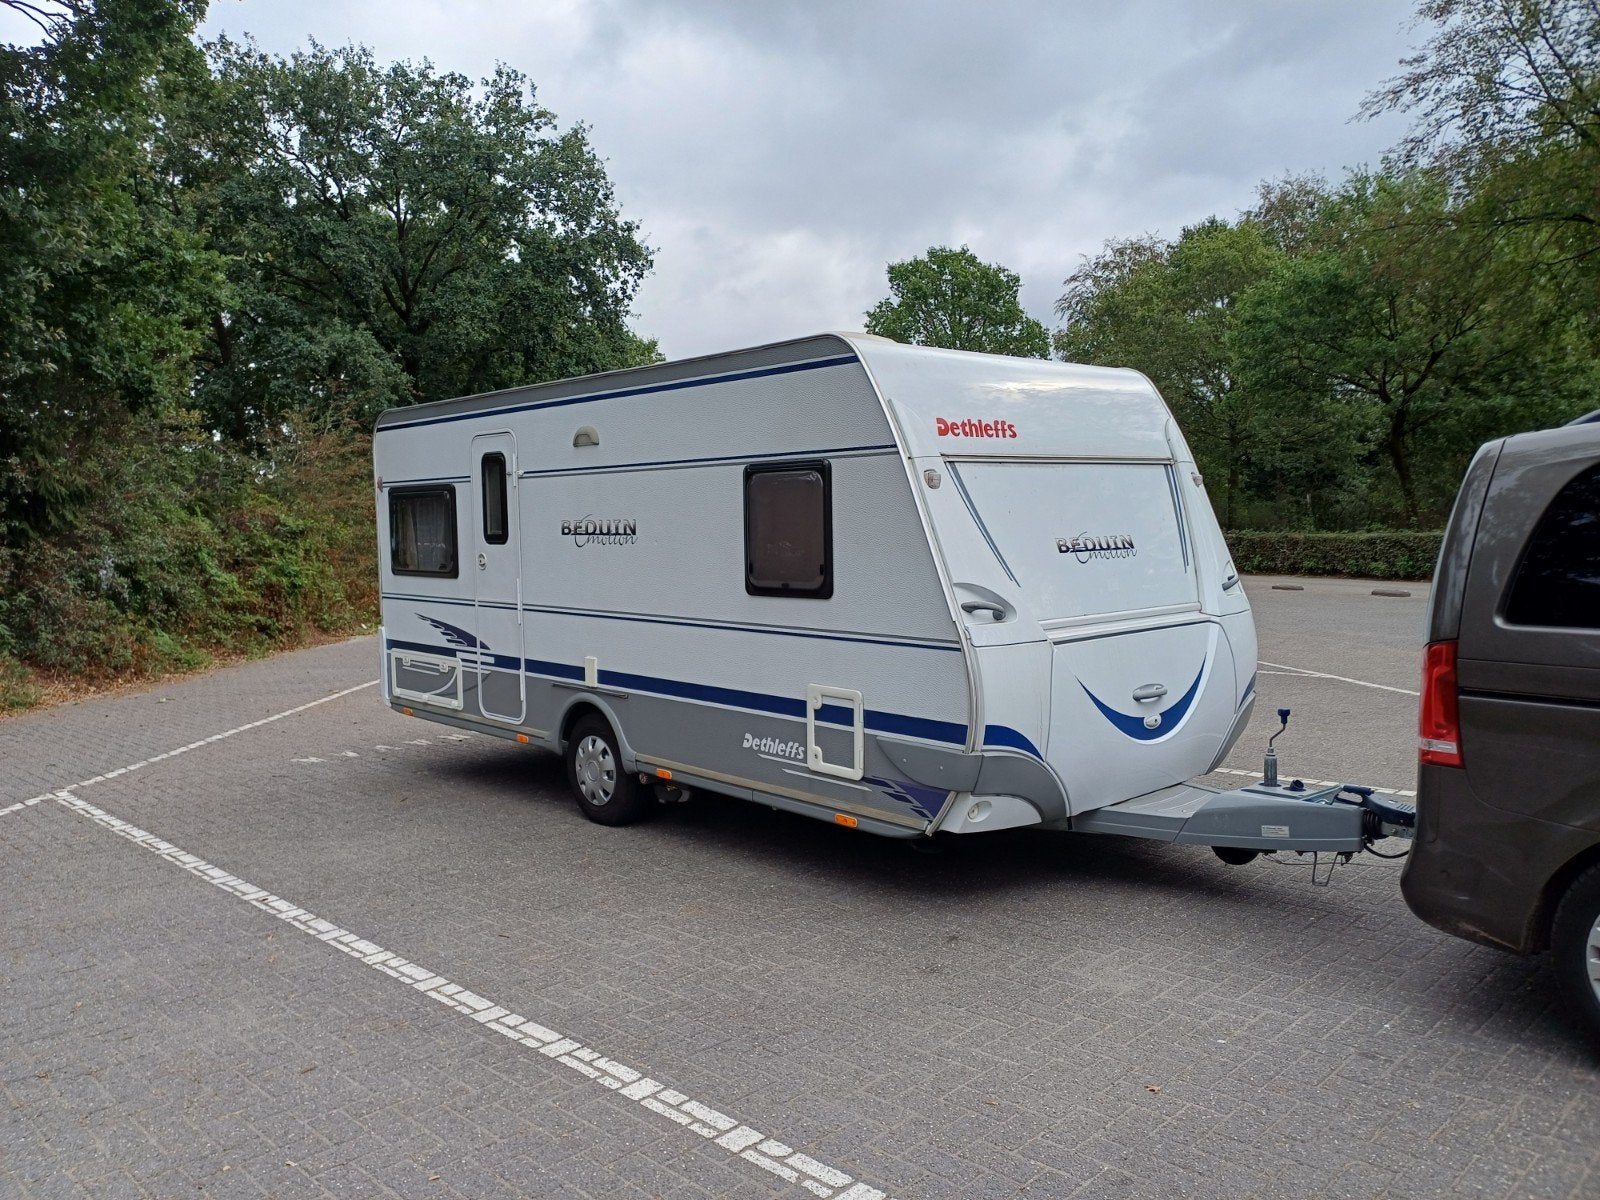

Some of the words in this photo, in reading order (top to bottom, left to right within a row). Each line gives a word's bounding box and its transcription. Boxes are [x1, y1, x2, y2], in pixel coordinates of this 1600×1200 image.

[936, 417, 1018, 438] Dethleffs
[561, 519, 637, 536] BEDUIN
[1055, 534, 1135, 554] BEDUIN
[742, 732, 805, 760] Dethleffs
